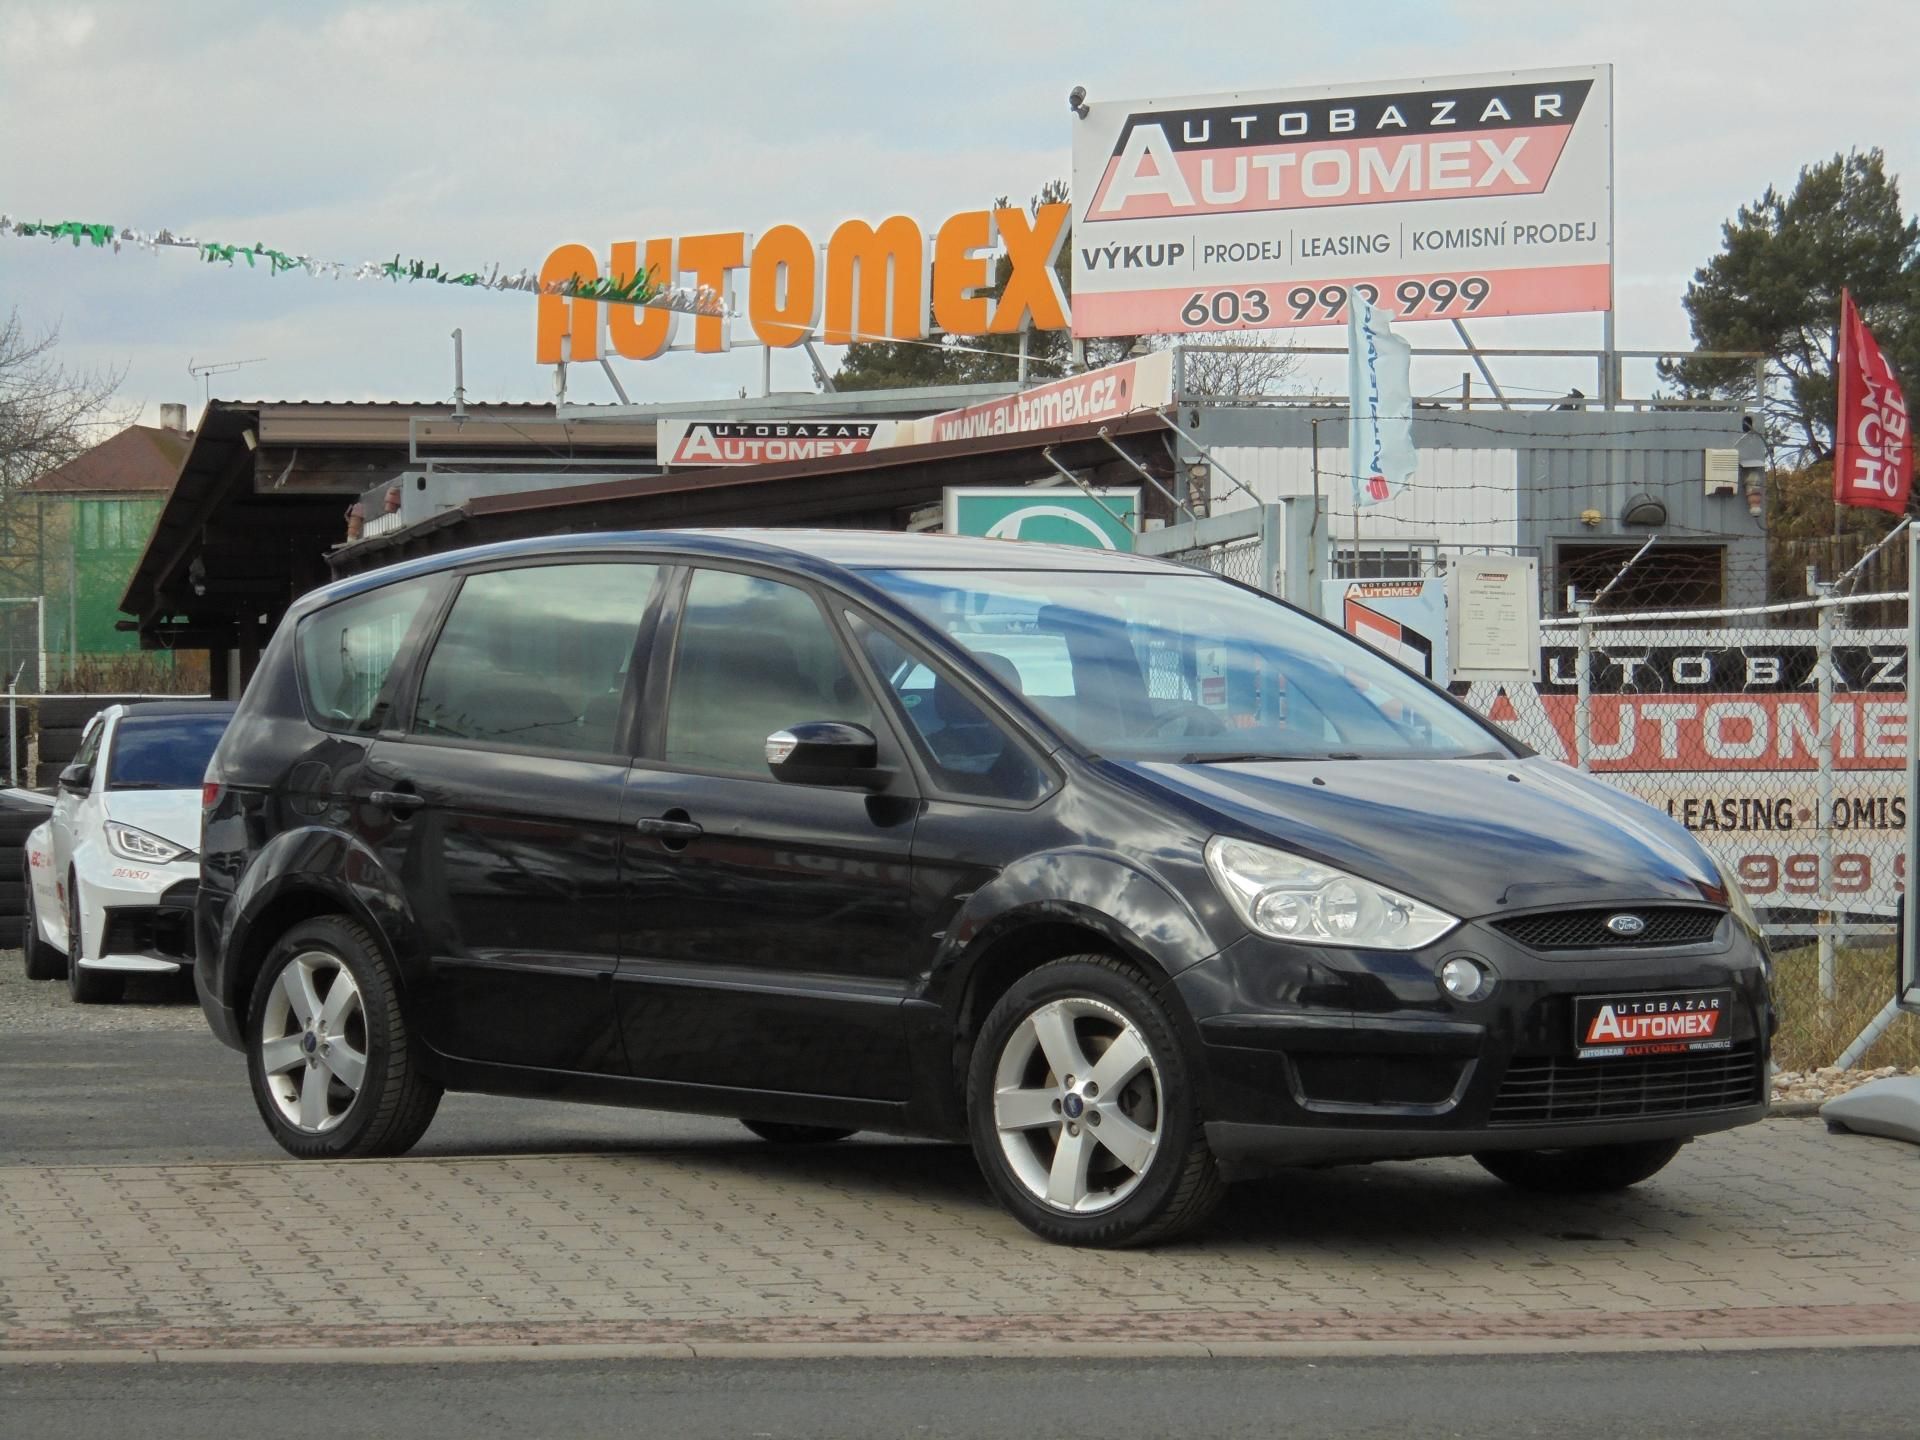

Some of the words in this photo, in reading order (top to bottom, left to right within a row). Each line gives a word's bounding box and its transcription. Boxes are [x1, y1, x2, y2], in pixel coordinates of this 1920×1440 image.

[1098, 123, 1532, 212] AUTOMEX
[1301, 233, 1391, 258] LEASING
[1412, 220, 1507, 251] KOMISNÍ
[1513, 221, 1597, 245] PRODEJ
[1081, 240, 1185, 271] VÝKUP
[1203, 239, 1282, 264] PRODEJ
[536, 203, 1072, 364] AUTOMEX
[1181, 289, 1270, 328] 603
[1396, 275, 1491, 316] 999
[941, 376, 1118, 442] www.automex.cz
[681, 426, 858, 461] AUTOMEX
[1347, 583, 1418, 598] AUTOMEX
[112, 868, 150, 880] DENSO
[1591, 1005, 1712, 1039] AUTOMEX
[1625, 1043, 1687, 1056] AUTOMEX
